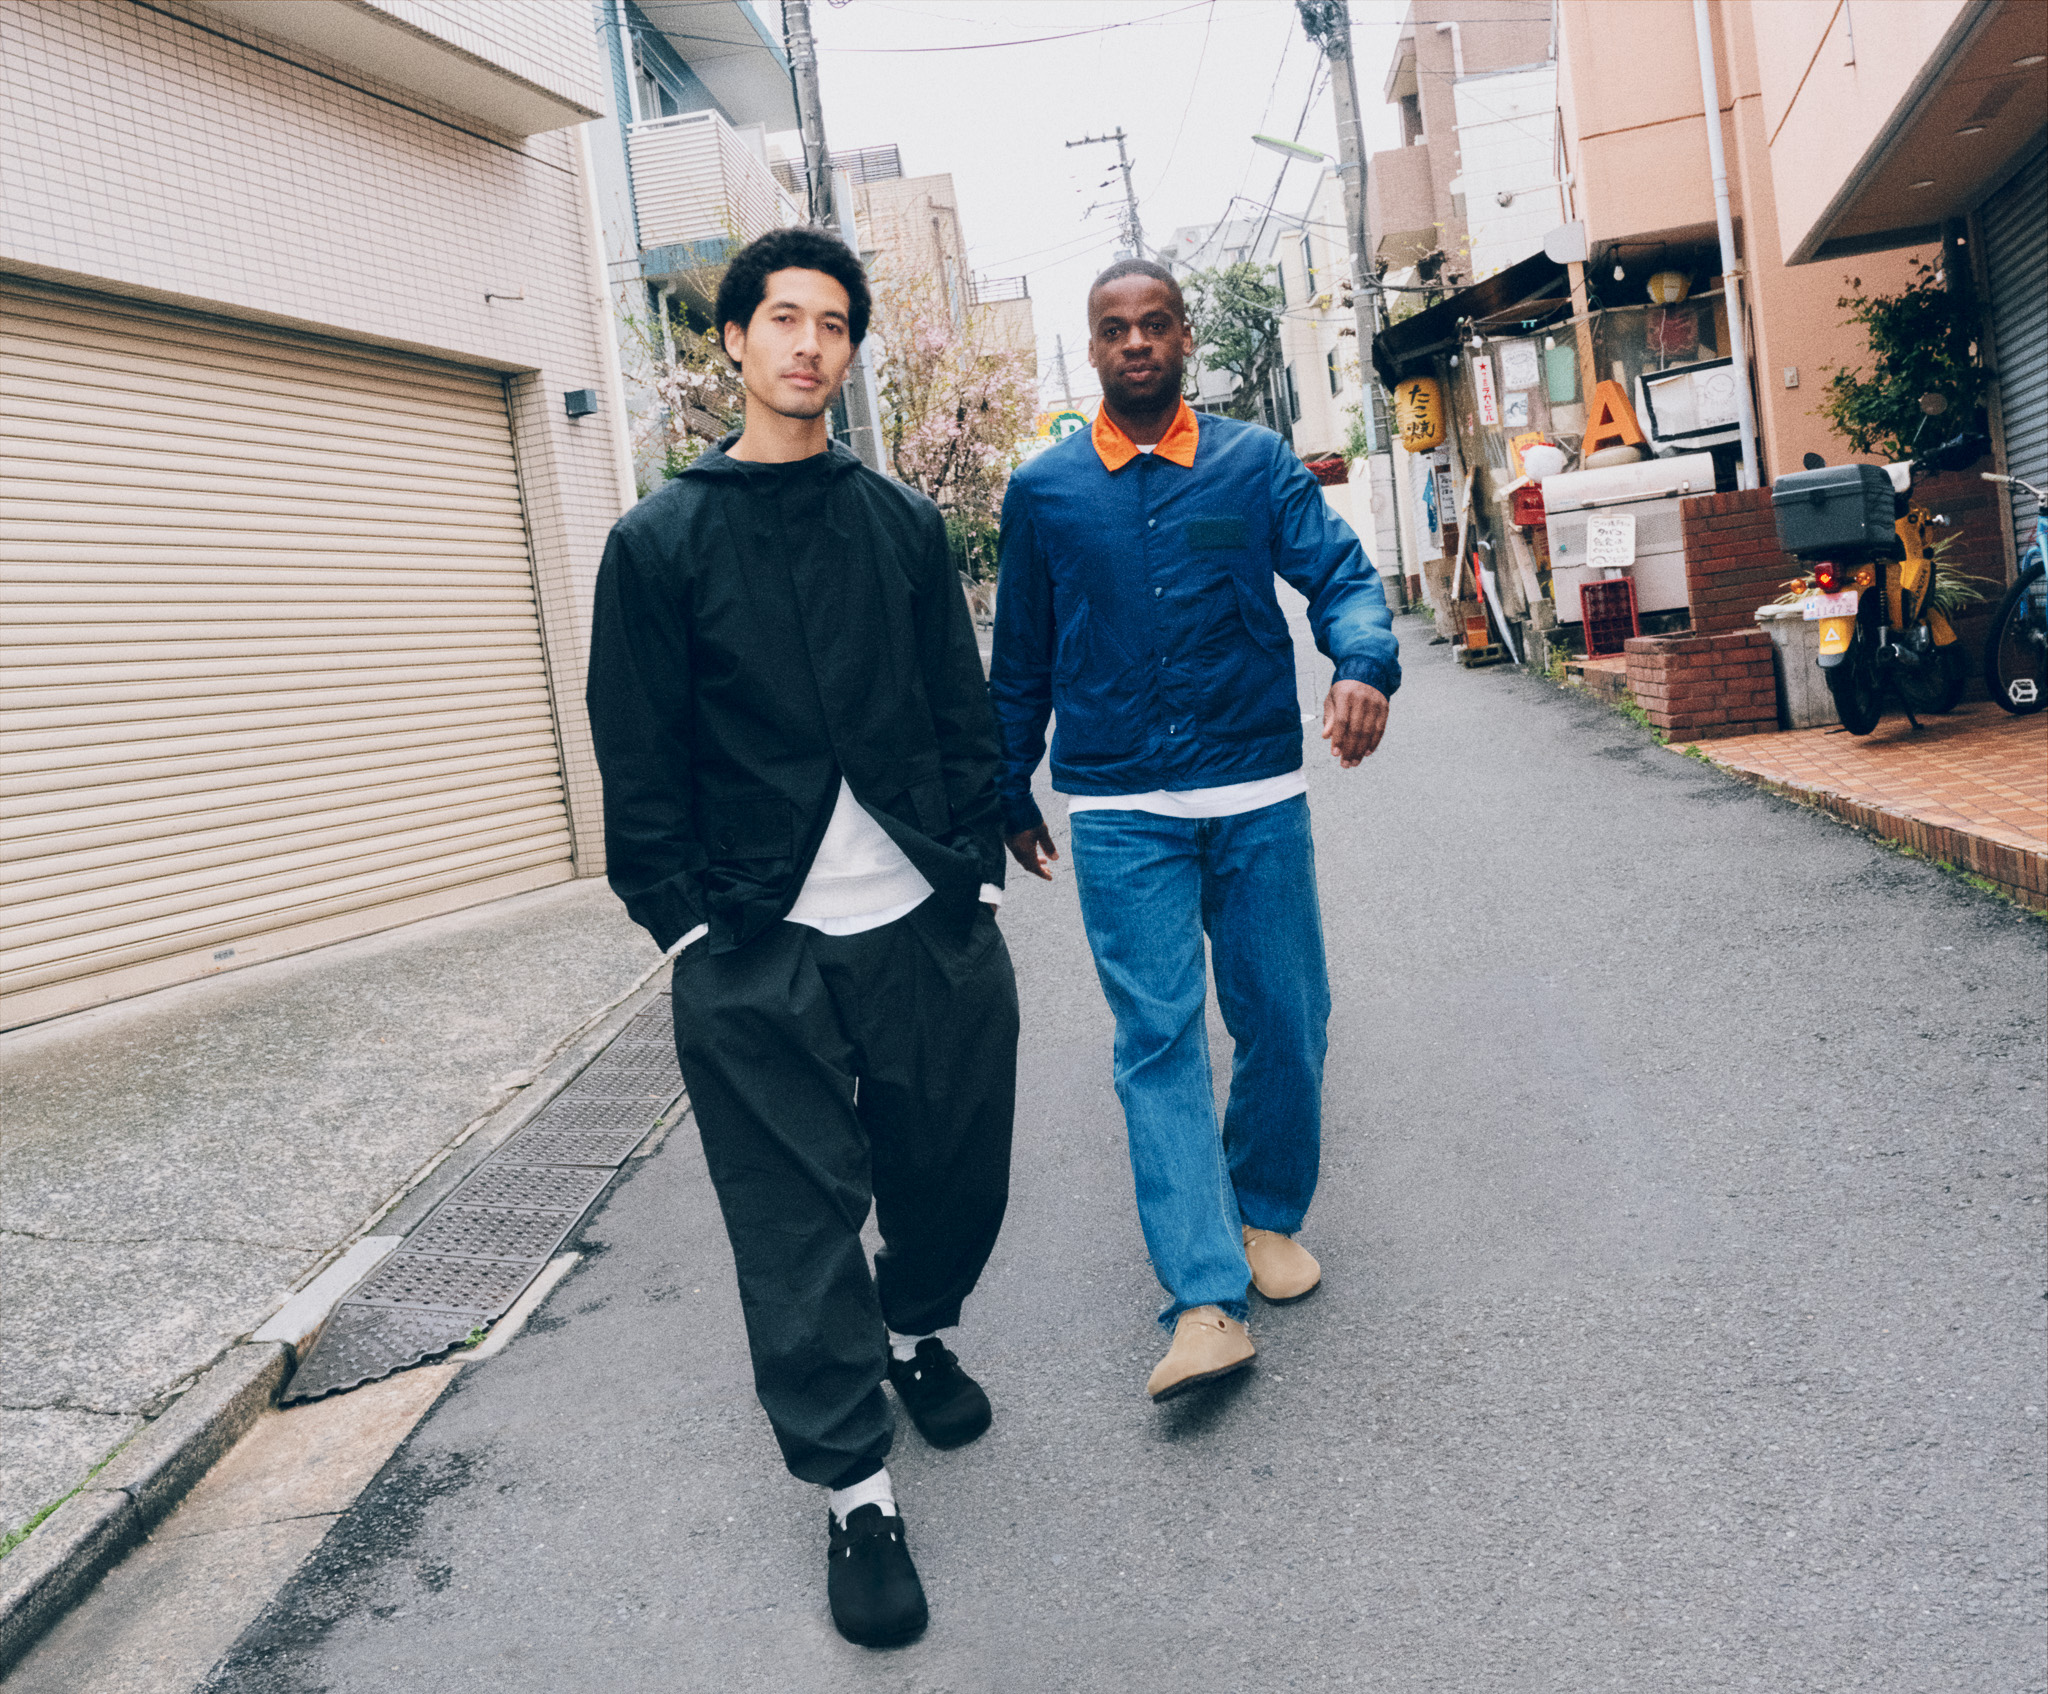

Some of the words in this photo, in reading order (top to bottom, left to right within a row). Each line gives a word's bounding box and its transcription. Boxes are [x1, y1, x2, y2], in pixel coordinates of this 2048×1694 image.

[1406, 384, 1435, 443] たこ焼
[1581, 379, 1645, 457] A
[1817, 603, 1842, 617] 1147
